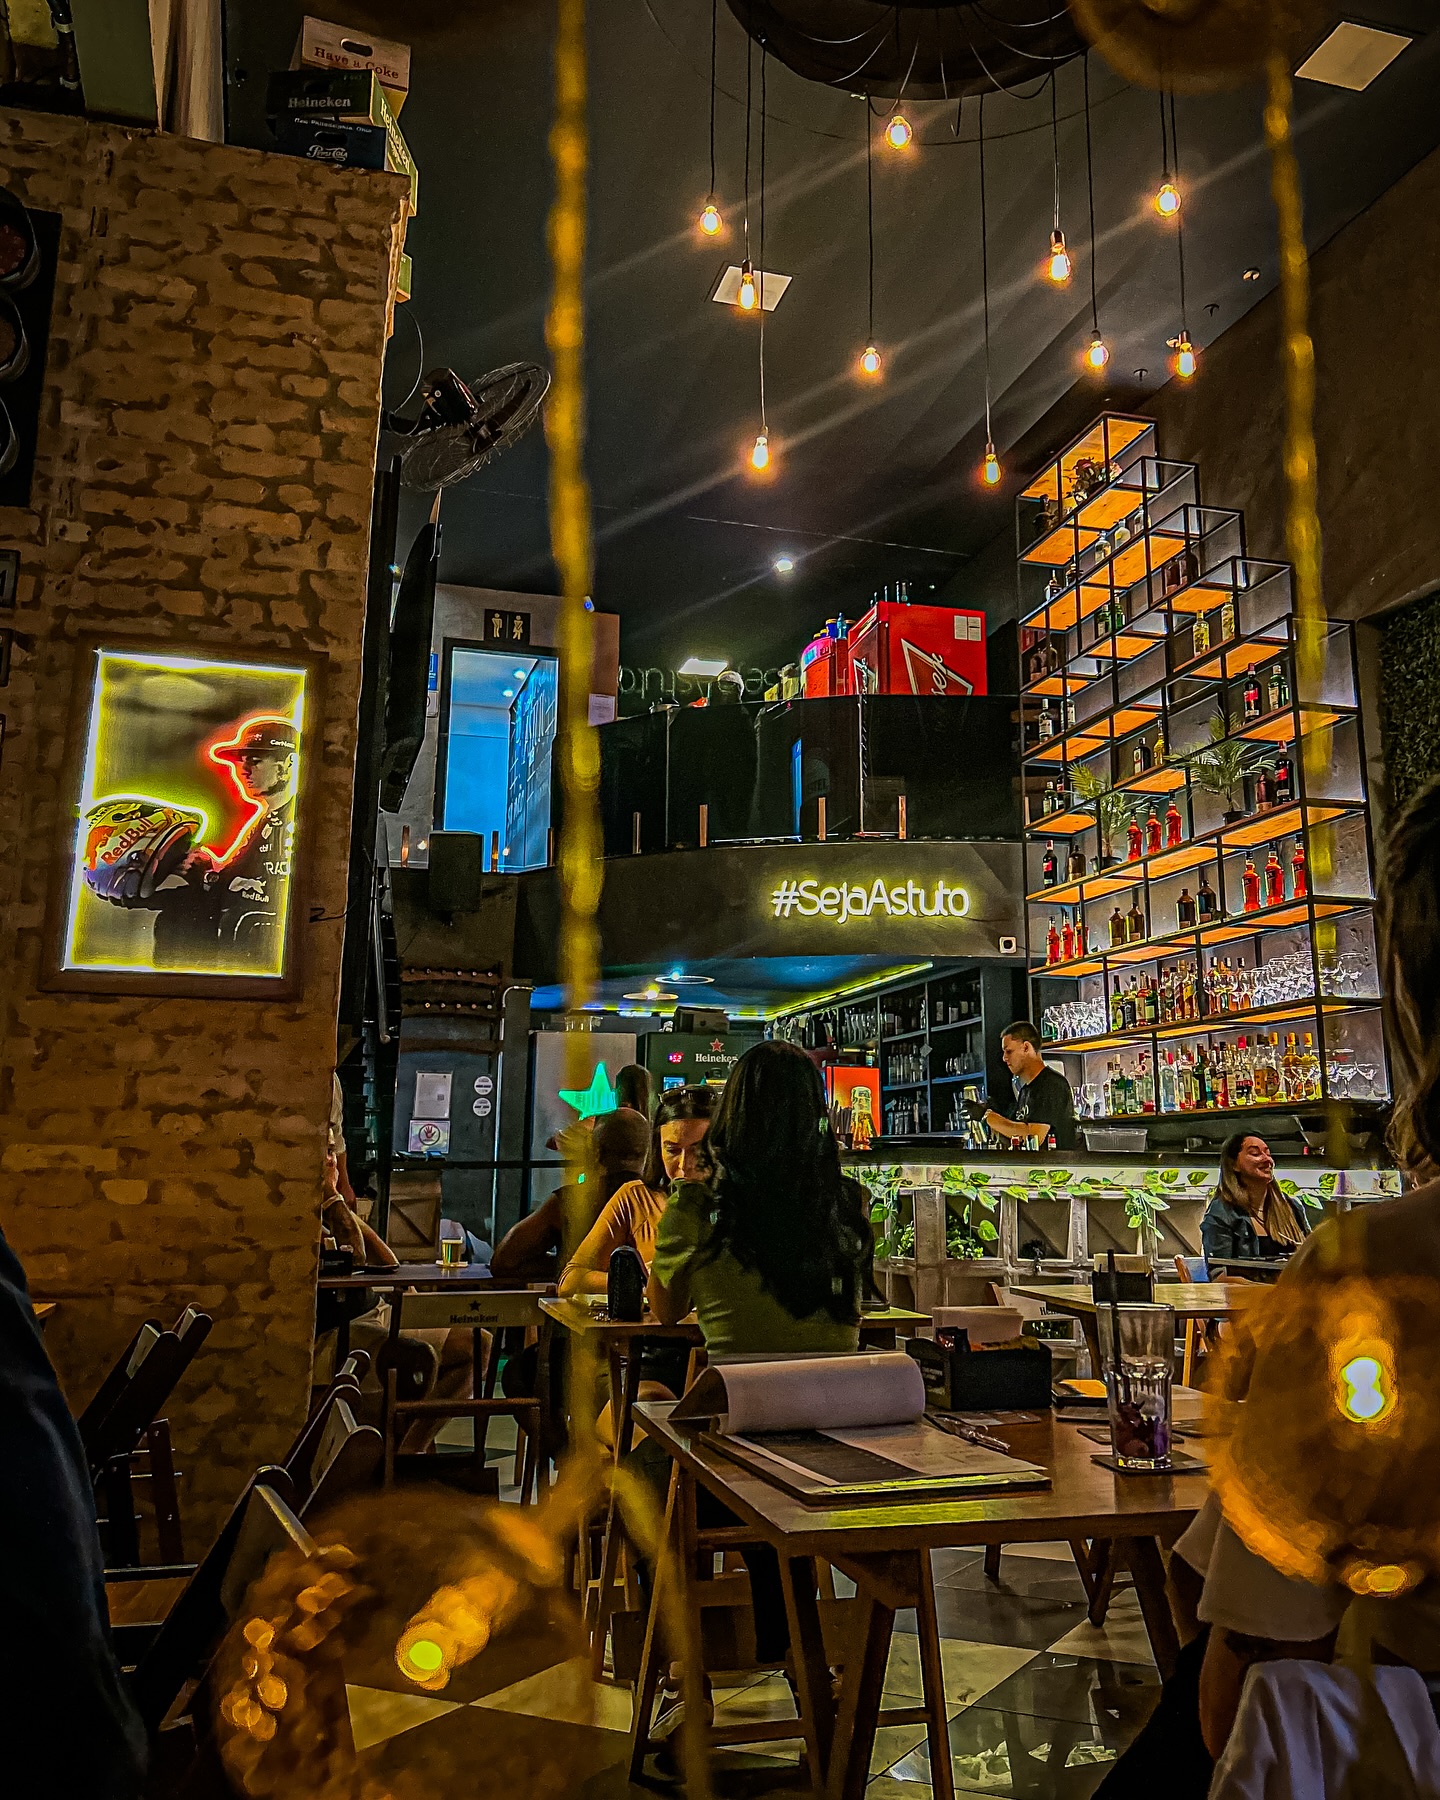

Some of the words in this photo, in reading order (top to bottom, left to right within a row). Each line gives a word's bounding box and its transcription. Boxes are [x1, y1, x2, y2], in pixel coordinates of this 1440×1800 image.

[314, 46, 349, 65] Have
[365, 61, 399, 78] Coke
[288, 97, 352, 109] Heineken
[771, 879, 970, 924] #SejaAstuto
[450, 1315, 498, 1323] Heineken
